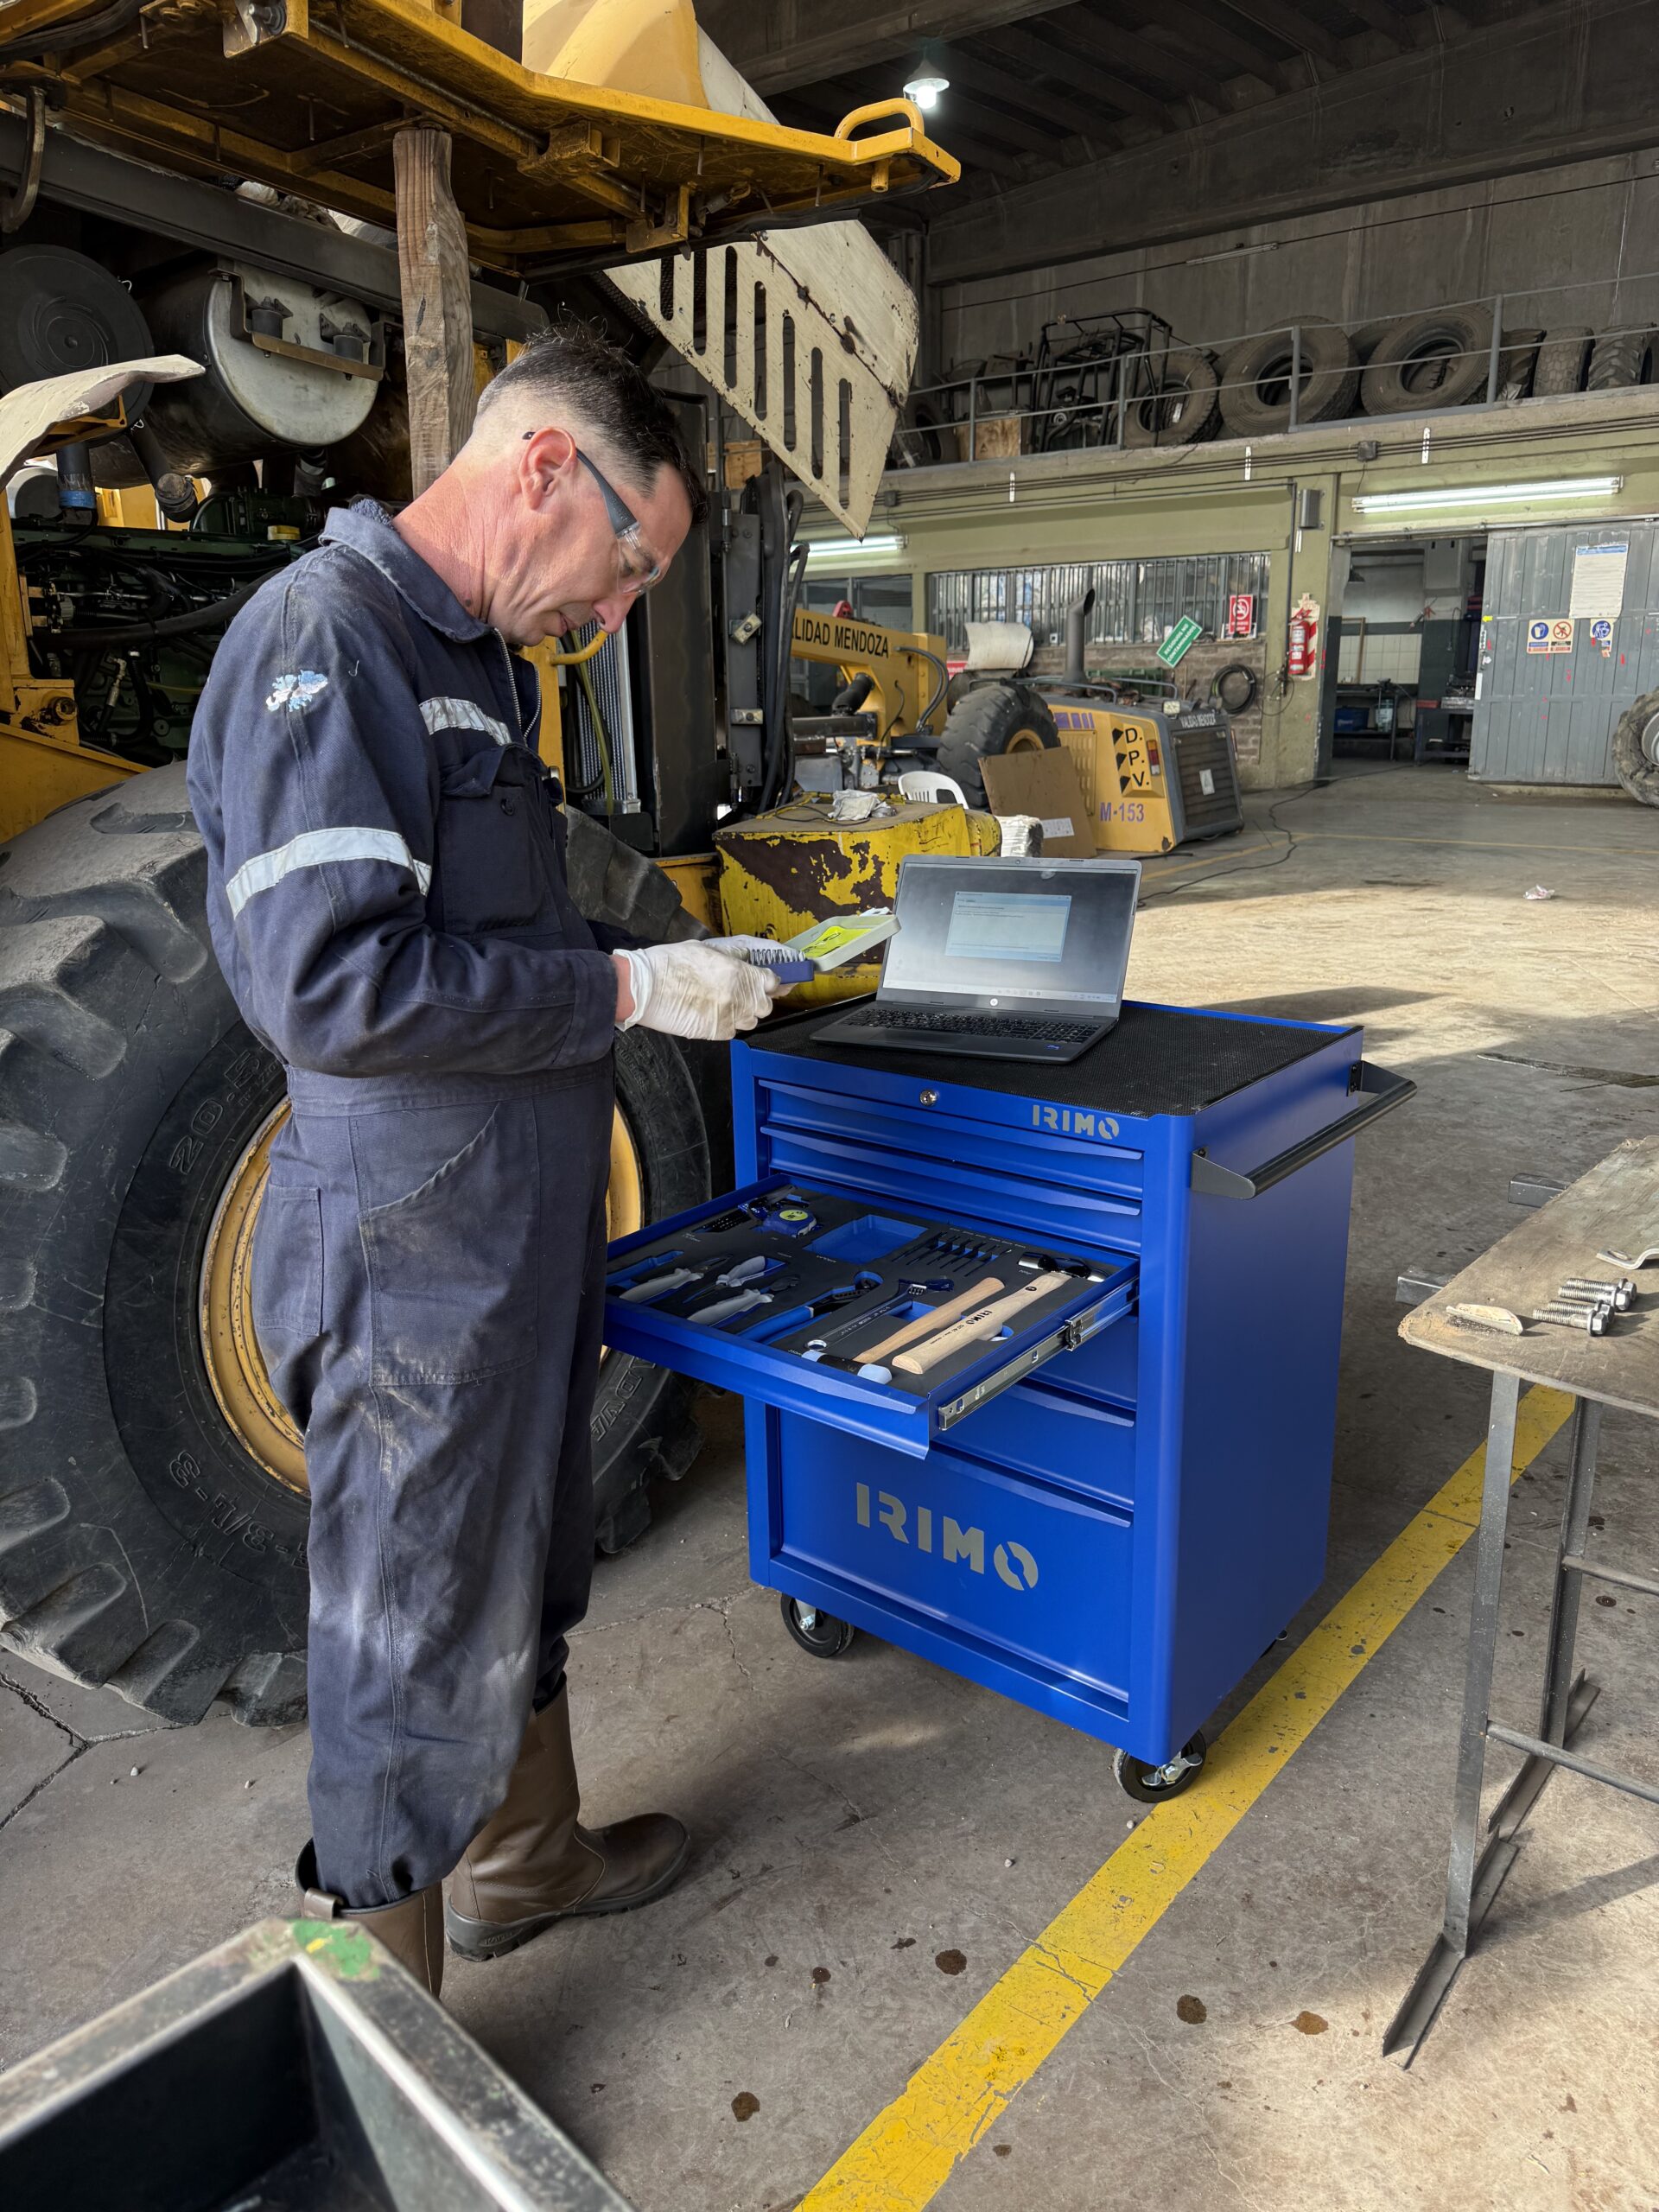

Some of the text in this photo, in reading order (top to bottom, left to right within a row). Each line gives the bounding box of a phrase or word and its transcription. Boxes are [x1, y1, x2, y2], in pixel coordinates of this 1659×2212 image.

[791, 617, 889, 658] LIDAD MENDOZA
[1167, 625, 1198, 662] CONTAMINADOS
[1125, 728, 1142, 744] D.
[1128, 750, 1145, 766] P.
[1132, 771, 1149, 786] V.
[1100, 802, 1144, 822] M-153
[1033, 1105, 1119, 1140] IRIMO
[965, 1310, 993, 1325] IRIMO
[856, 1482, 1039, 1591] IRIMO
